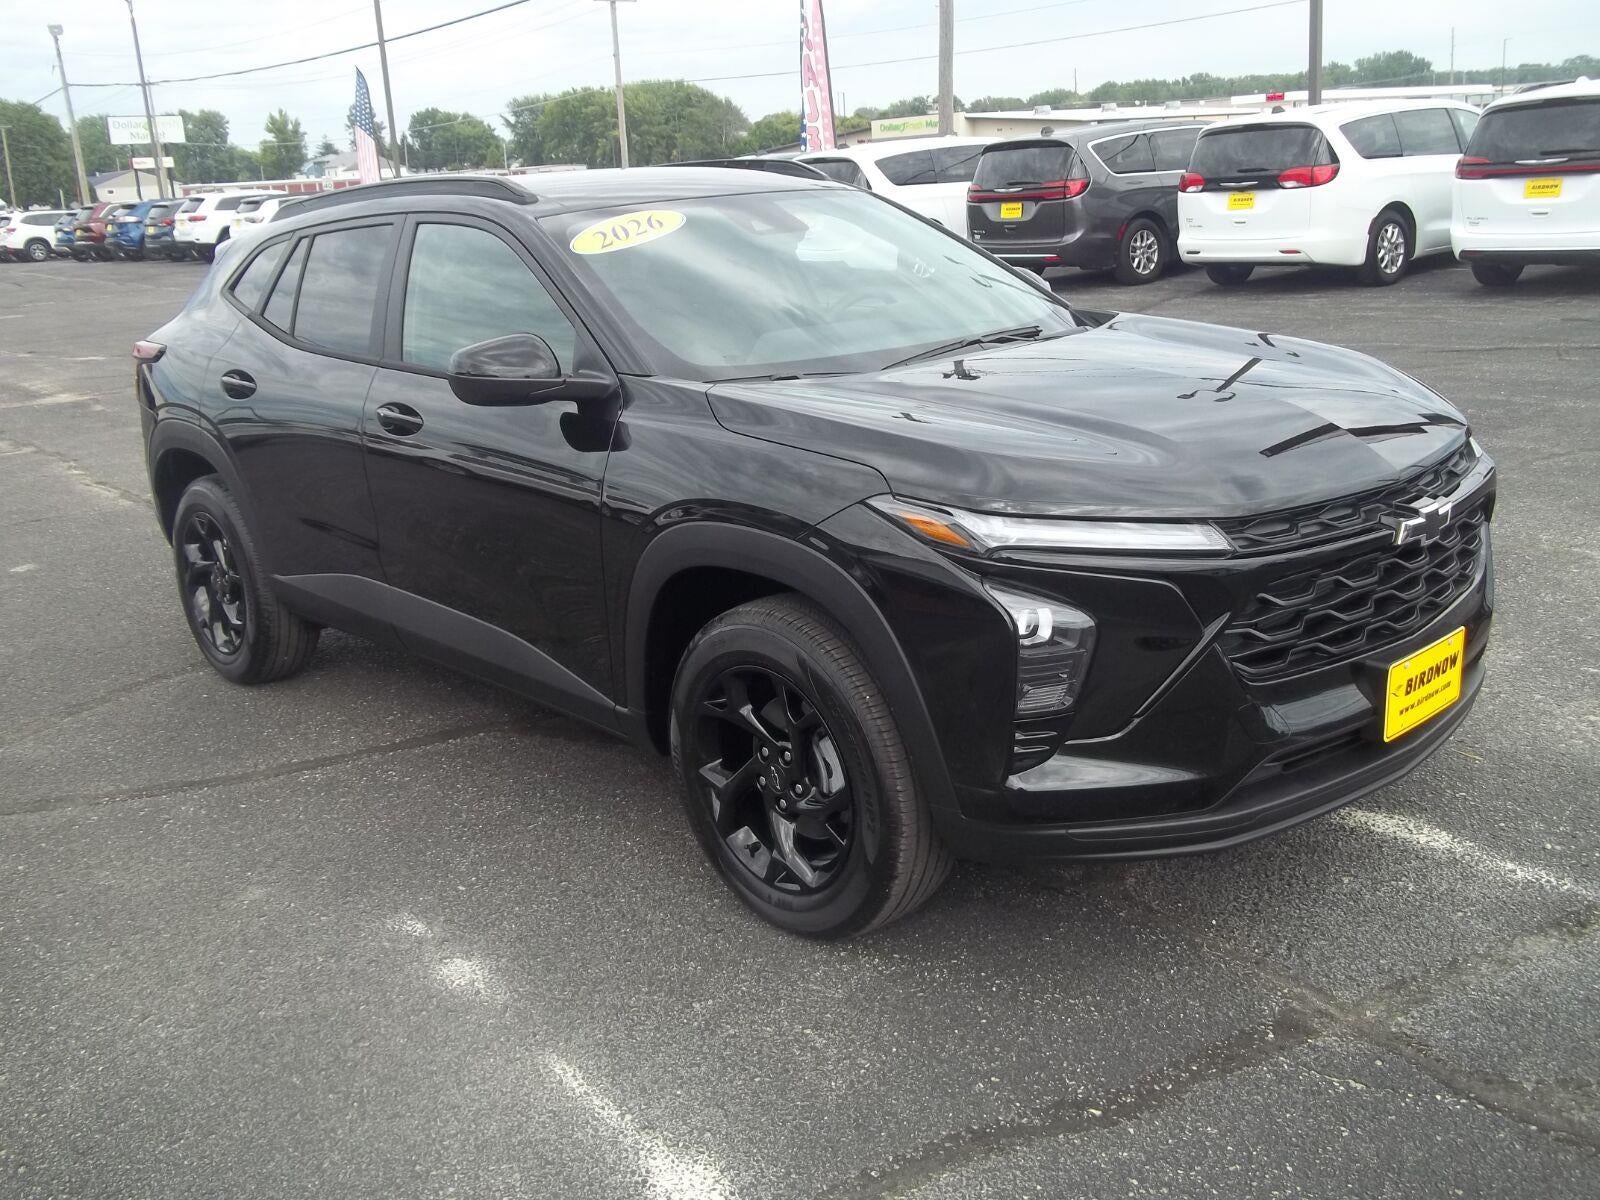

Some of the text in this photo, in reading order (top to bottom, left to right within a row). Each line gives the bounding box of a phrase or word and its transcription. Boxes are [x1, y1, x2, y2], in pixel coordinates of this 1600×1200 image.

[112, 120, 142, 129] Dollar
[592, 214, 664, 249] 2026
[1404, 650, 1460, 697] BIRDNOW
